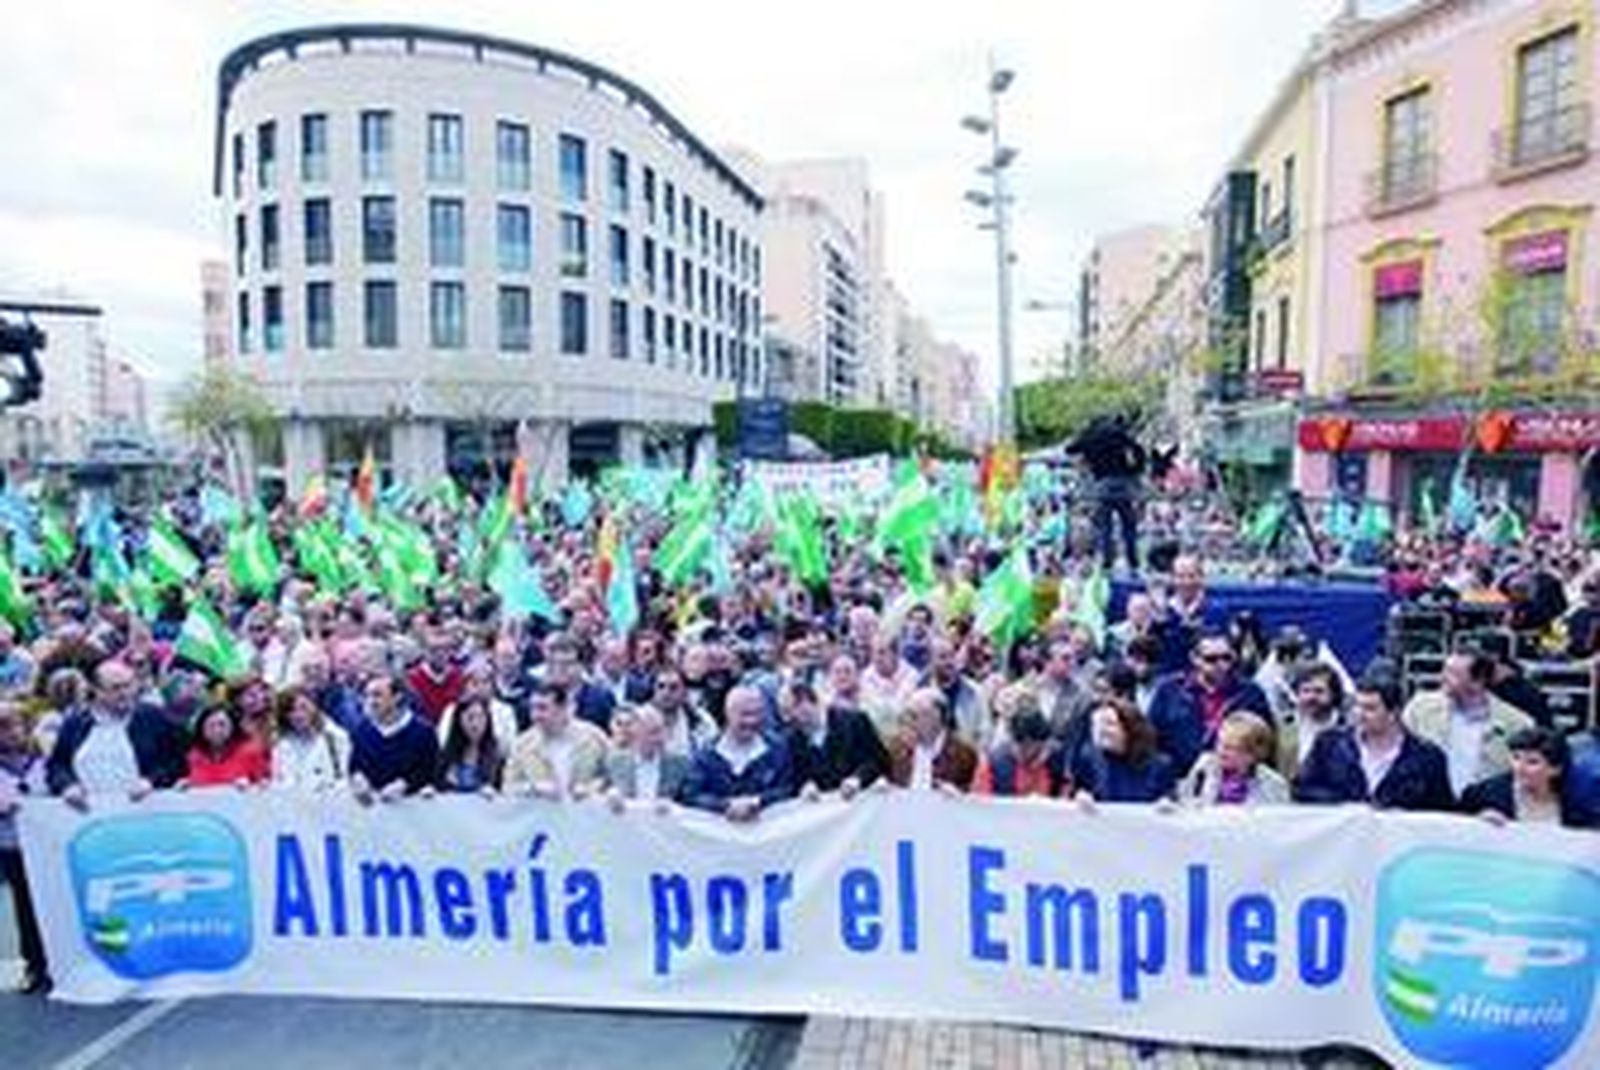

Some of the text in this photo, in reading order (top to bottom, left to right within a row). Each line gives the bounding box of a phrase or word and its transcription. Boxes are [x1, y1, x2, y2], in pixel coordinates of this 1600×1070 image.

[272, 833, 1348, 1002] Almería por el Empleo
